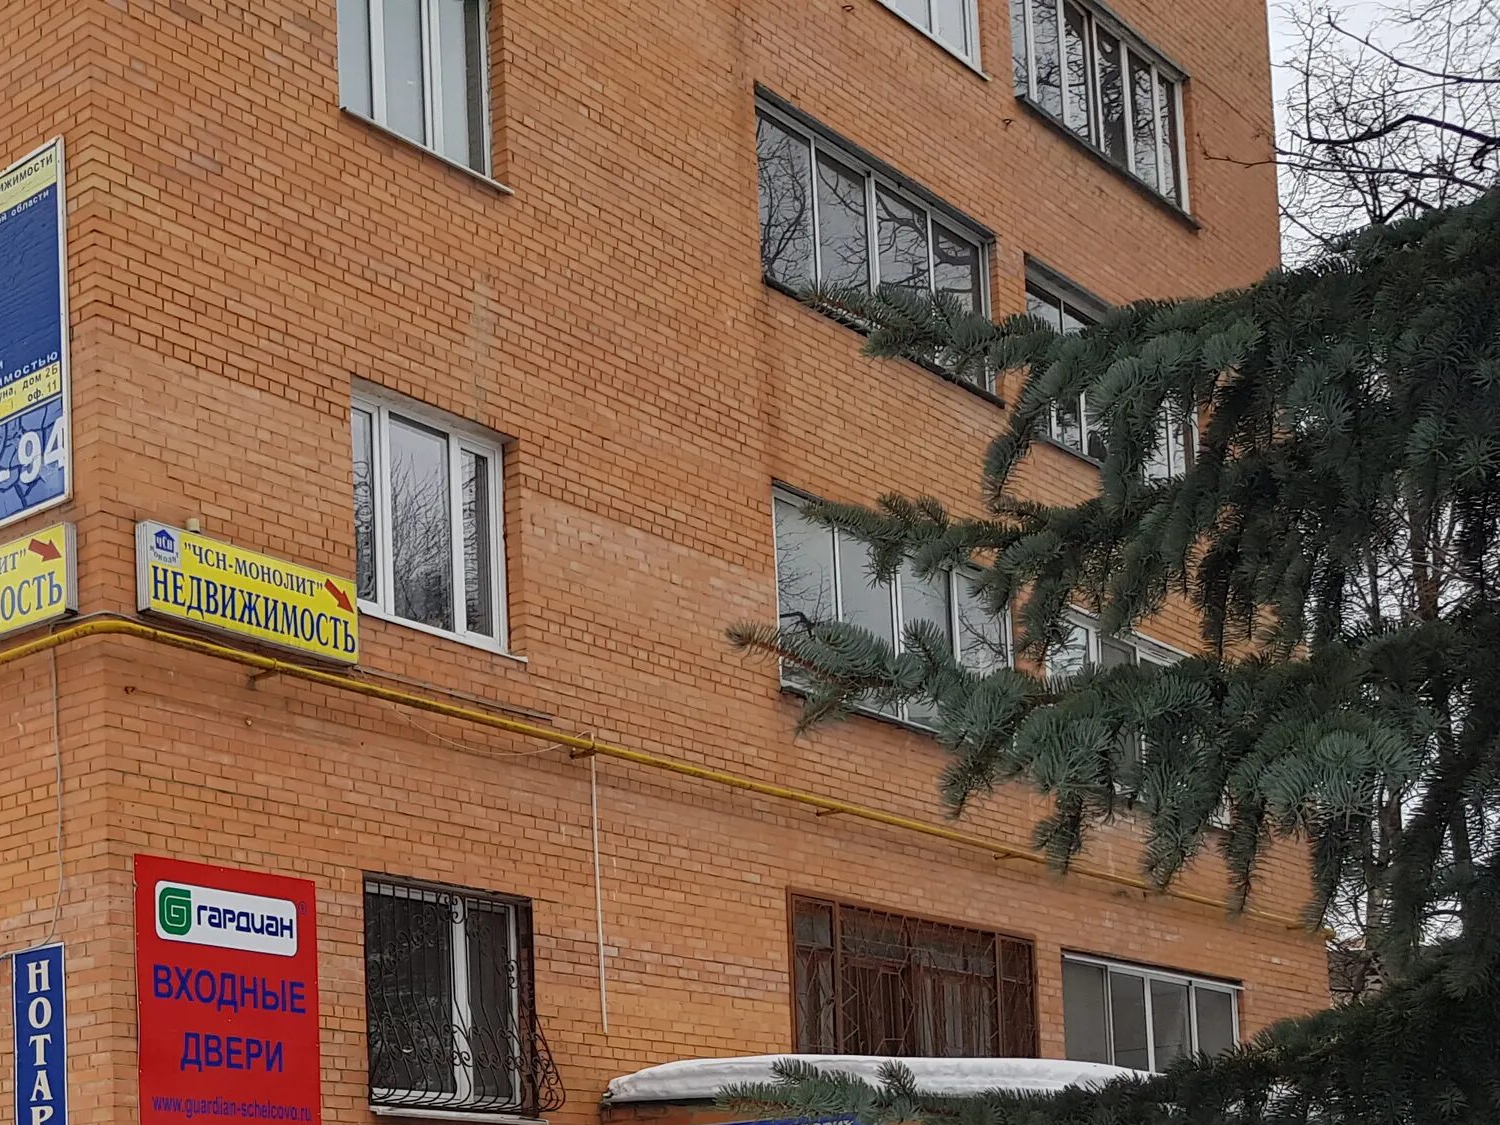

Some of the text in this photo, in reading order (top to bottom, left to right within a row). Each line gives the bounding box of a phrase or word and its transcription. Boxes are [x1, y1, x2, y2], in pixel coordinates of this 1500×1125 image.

[11, 190, 49, 216] области
[22, 374, 42, 391] дом
[27, 380, 57, 402] оф. 11
[184, 542, 323, 598] "ЧСН-МОНОЛИТ"
[151, 564, 356, 653] НЕДВИЖИМОСТЬ
[153, 963, 307, 1015] ВХОДНЫЕ
[180, 1031, 284, 1073] ДВЕРИ
